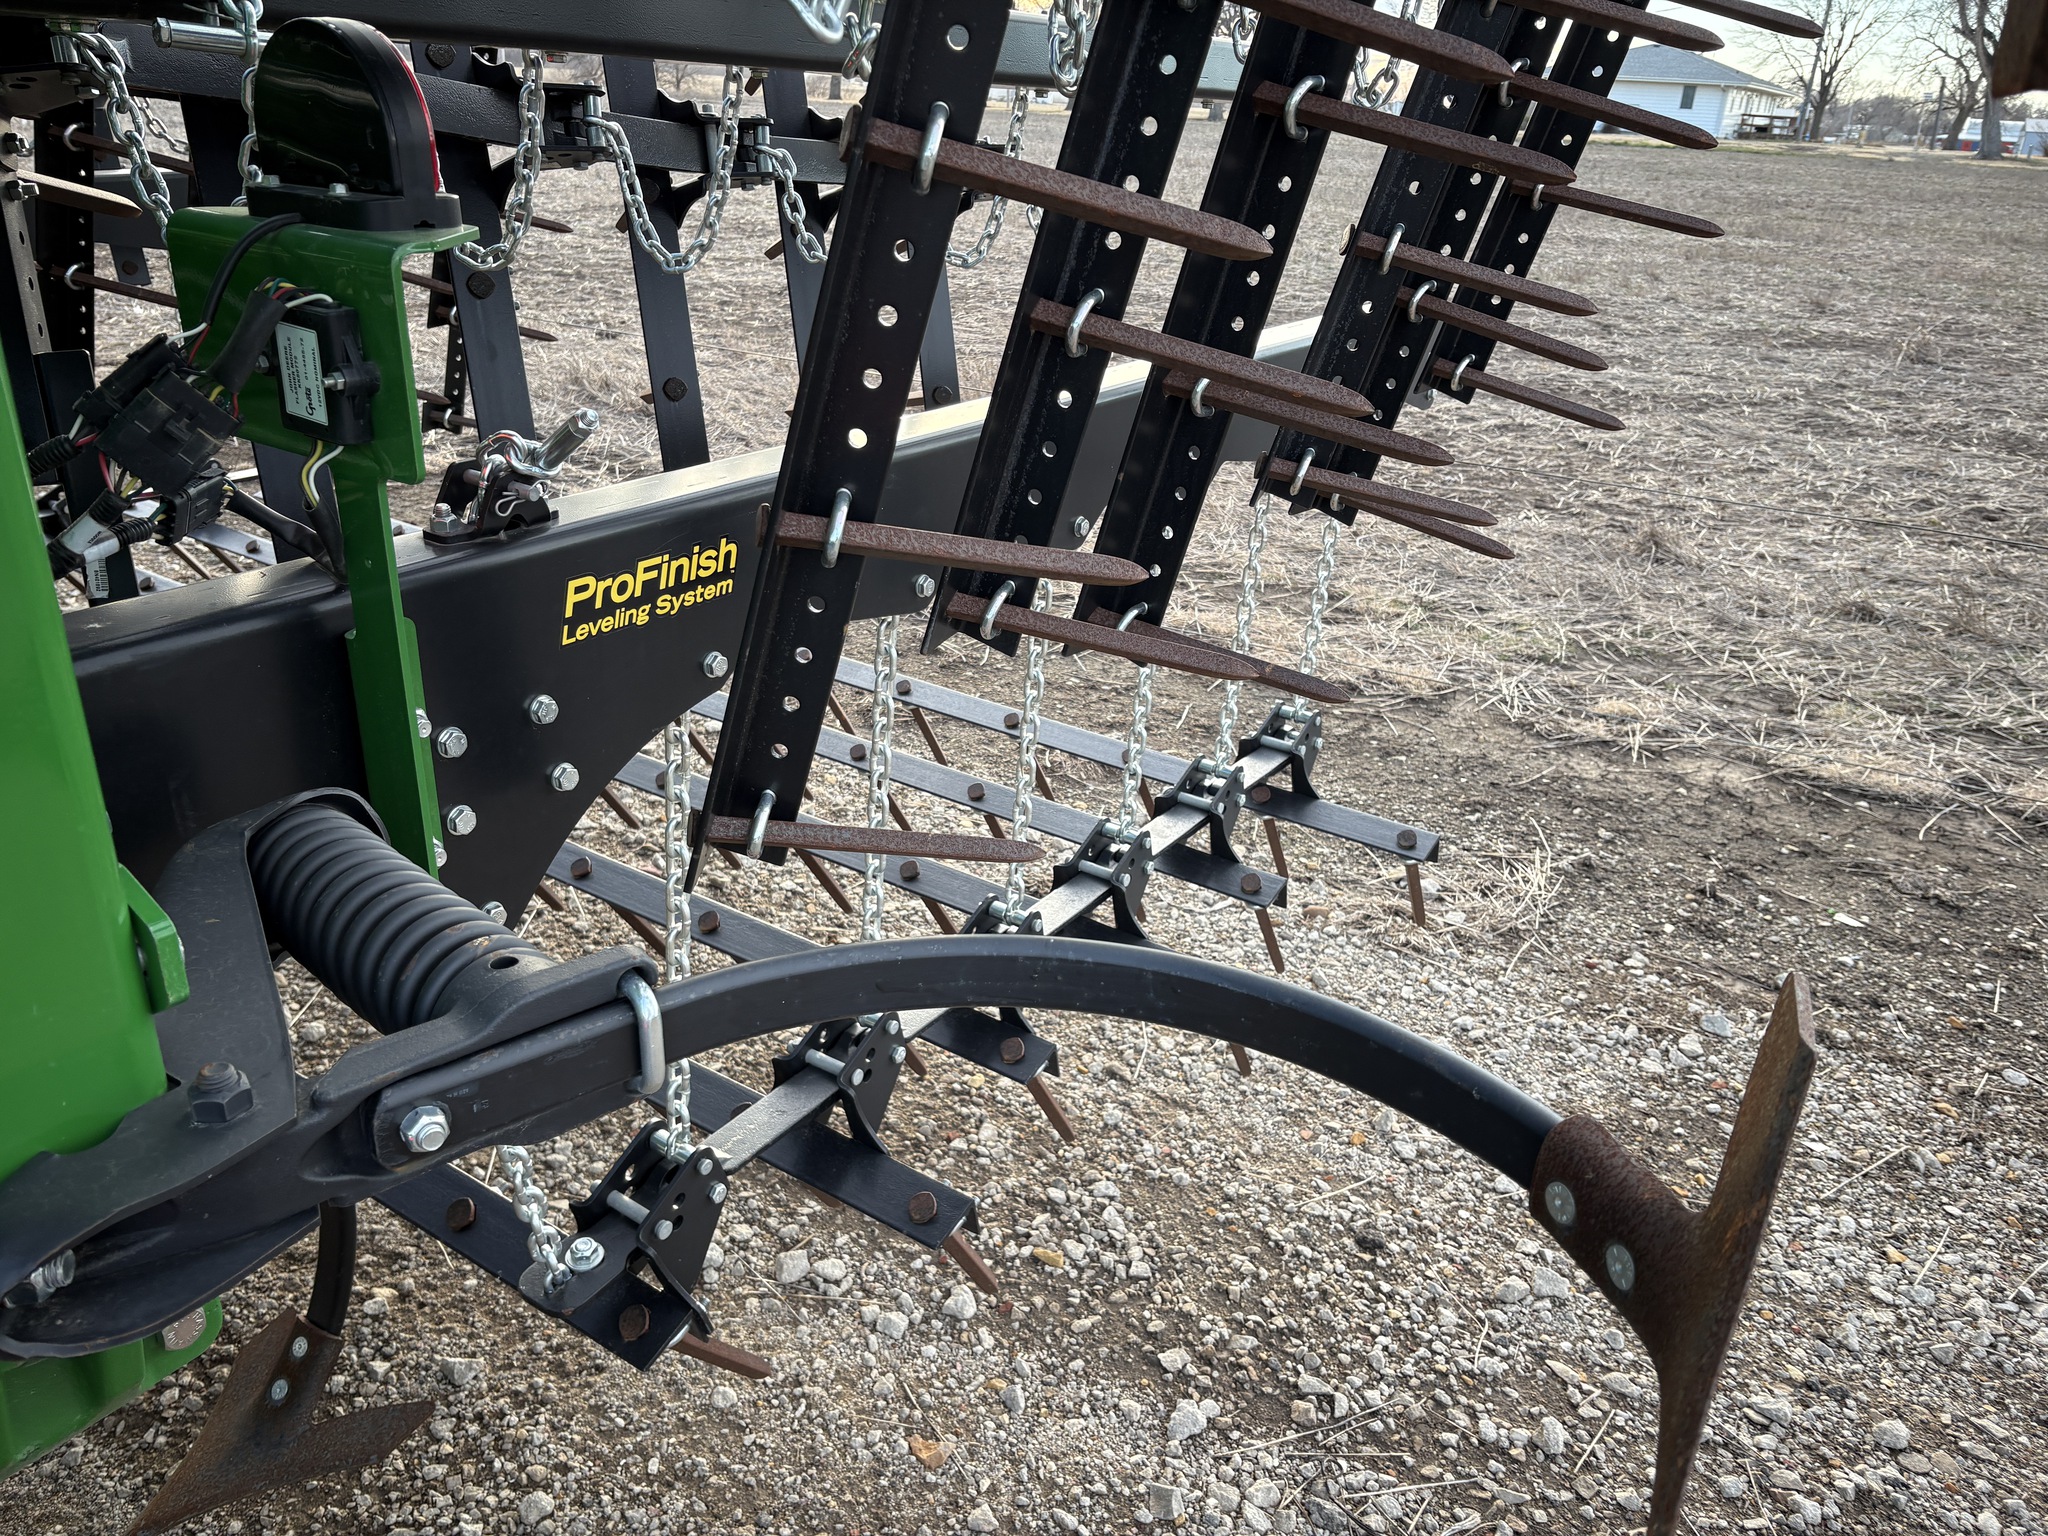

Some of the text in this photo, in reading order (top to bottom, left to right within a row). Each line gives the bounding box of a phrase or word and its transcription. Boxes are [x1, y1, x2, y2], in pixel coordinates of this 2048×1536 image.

[311, 346, 319, 382] NOMINAL
[562, 578, 734, 646] Leveling System
[565, 538, 738, 618] ProFinish
